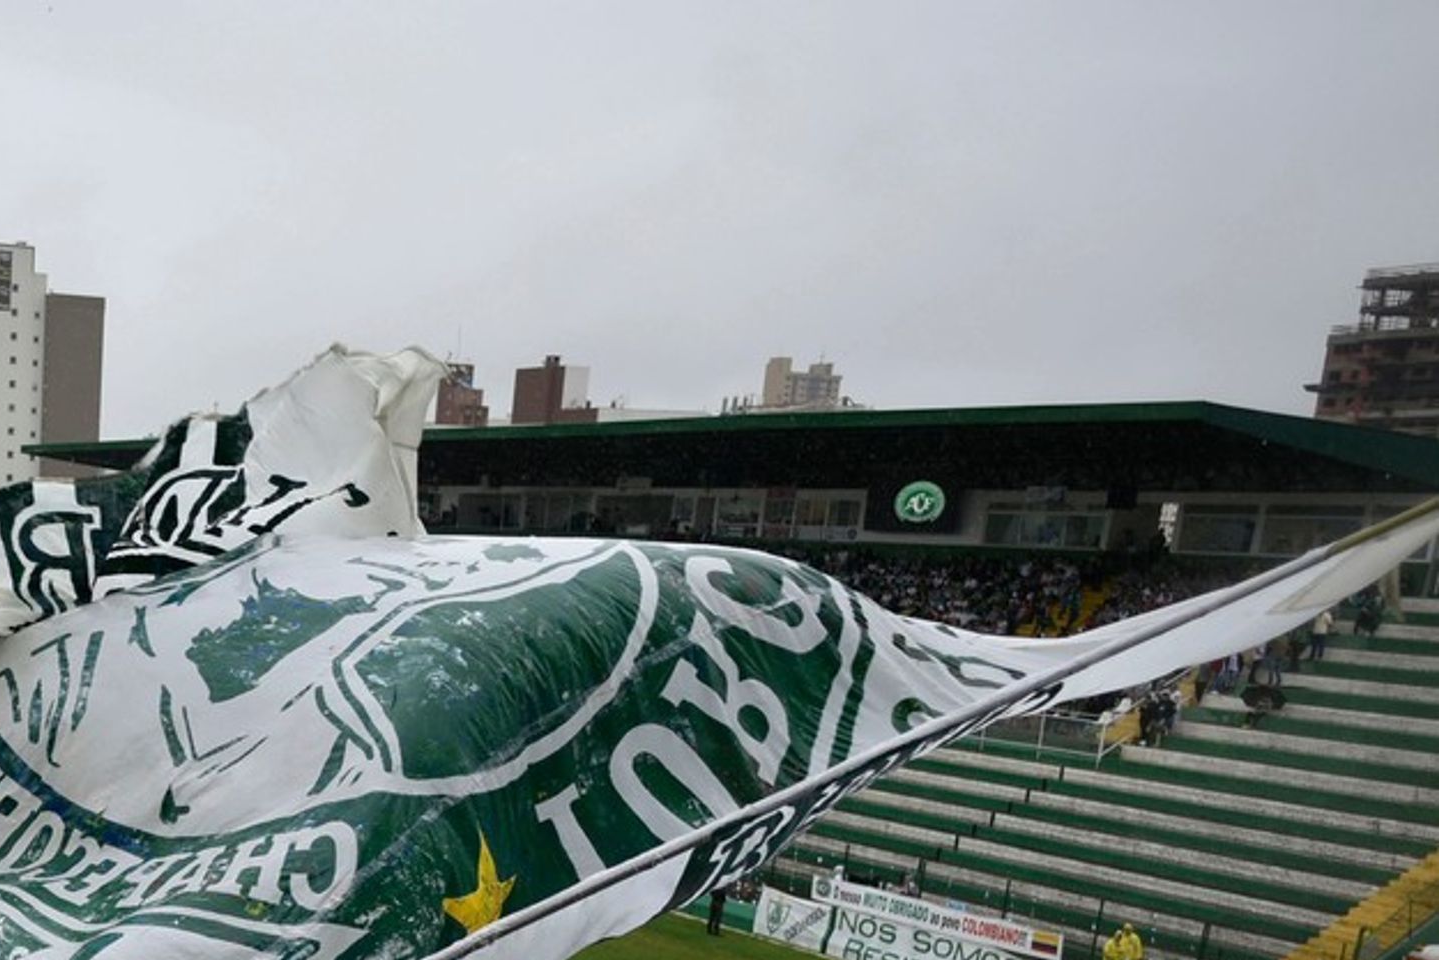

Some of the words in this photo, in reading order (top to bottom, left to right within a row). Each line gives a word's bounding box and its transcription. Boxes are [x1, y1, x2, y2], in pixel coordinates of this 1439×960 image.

[839, 909, 897, 944] NÓS
[889, 897, 929, 923] OBRIGADO
[941, 915, 960, 931] povo
